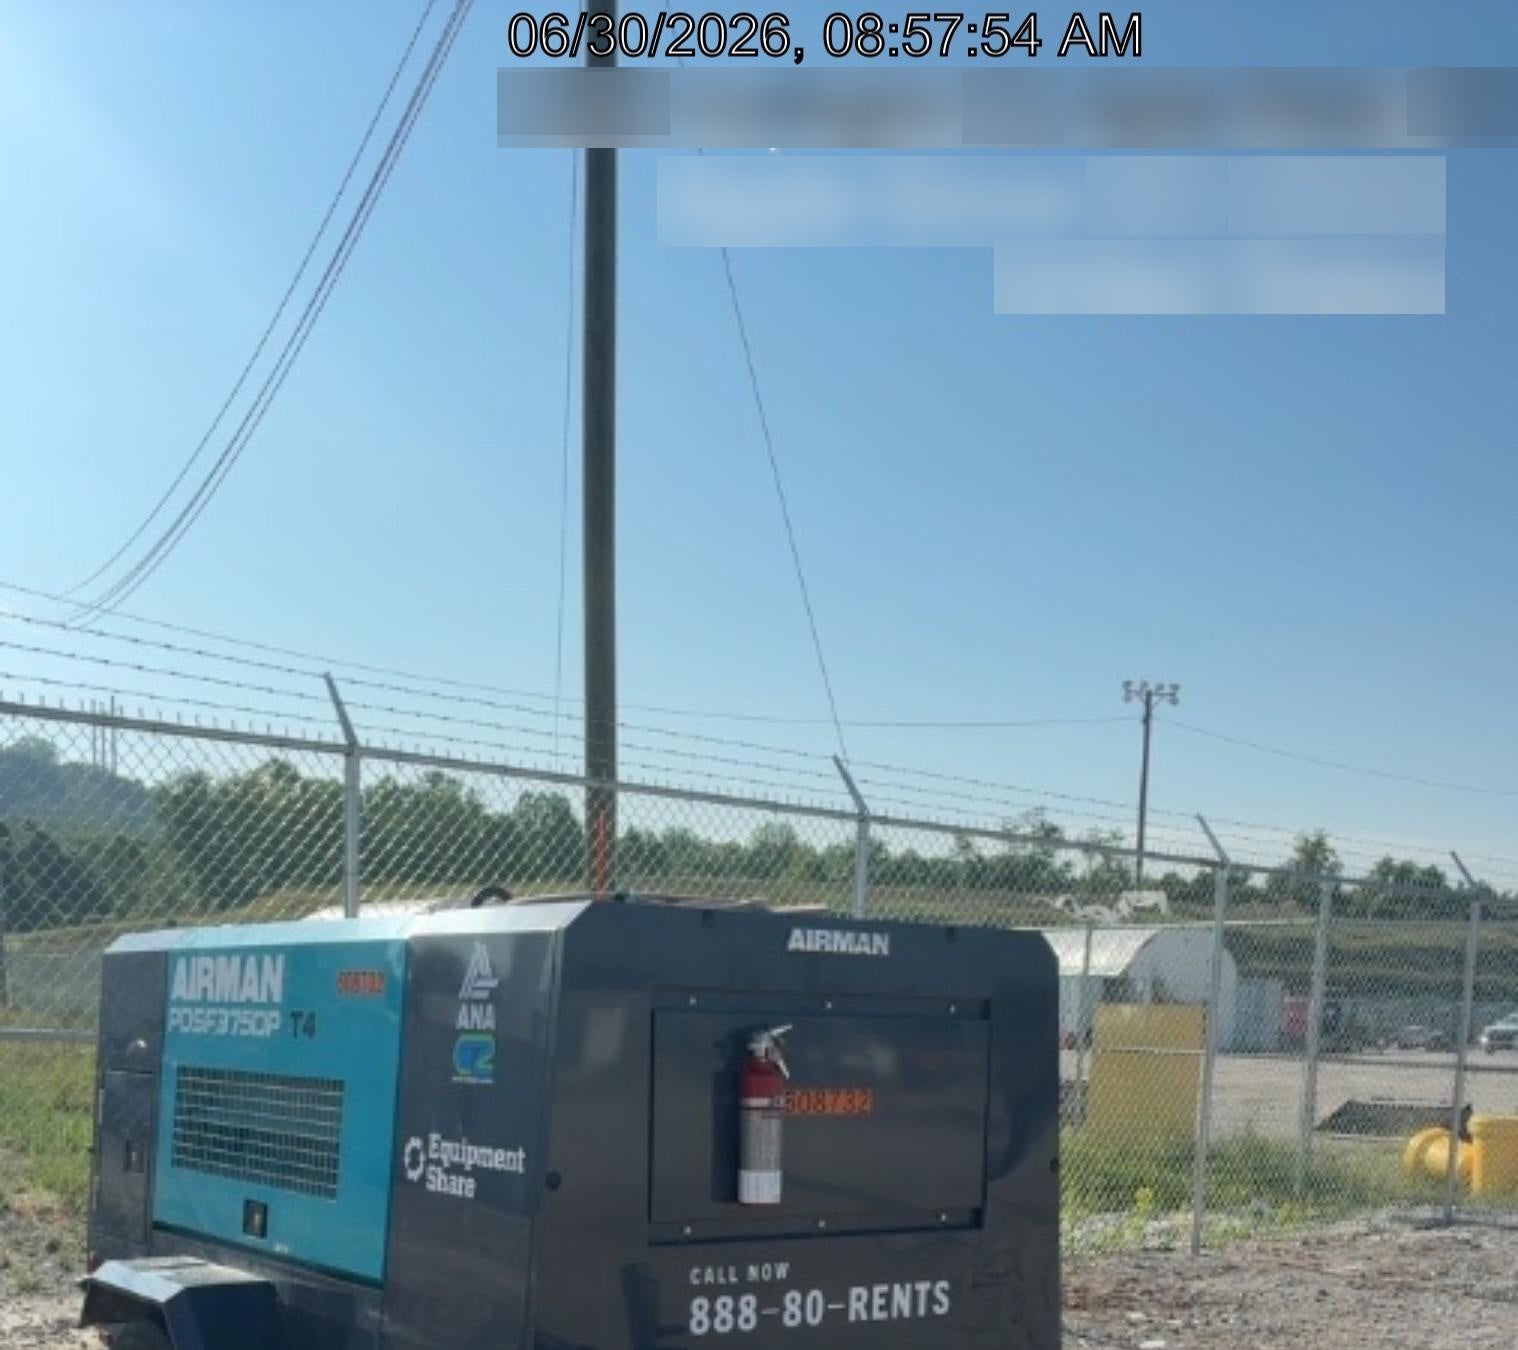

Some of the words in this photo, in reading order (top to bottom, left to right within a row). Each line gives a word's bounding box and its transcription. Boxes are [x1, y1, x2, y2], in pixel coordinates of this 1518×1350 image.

[787, 929, 889, 955] AIRMAN
[170, 954, 285, 1003] AIRMAN
[291, 1011, 316, 1039] T4
[456, 1004, 496, 1030] ANA
[428, 1133, 526, 1174] Equipment
[425, 1164, 477, 1198] Share
[690, 1265, 739, 1285] CALL
[747, 1262, 790, 1282] NOW
[689, 1280, 950, 1336] 888-80-RENTS
